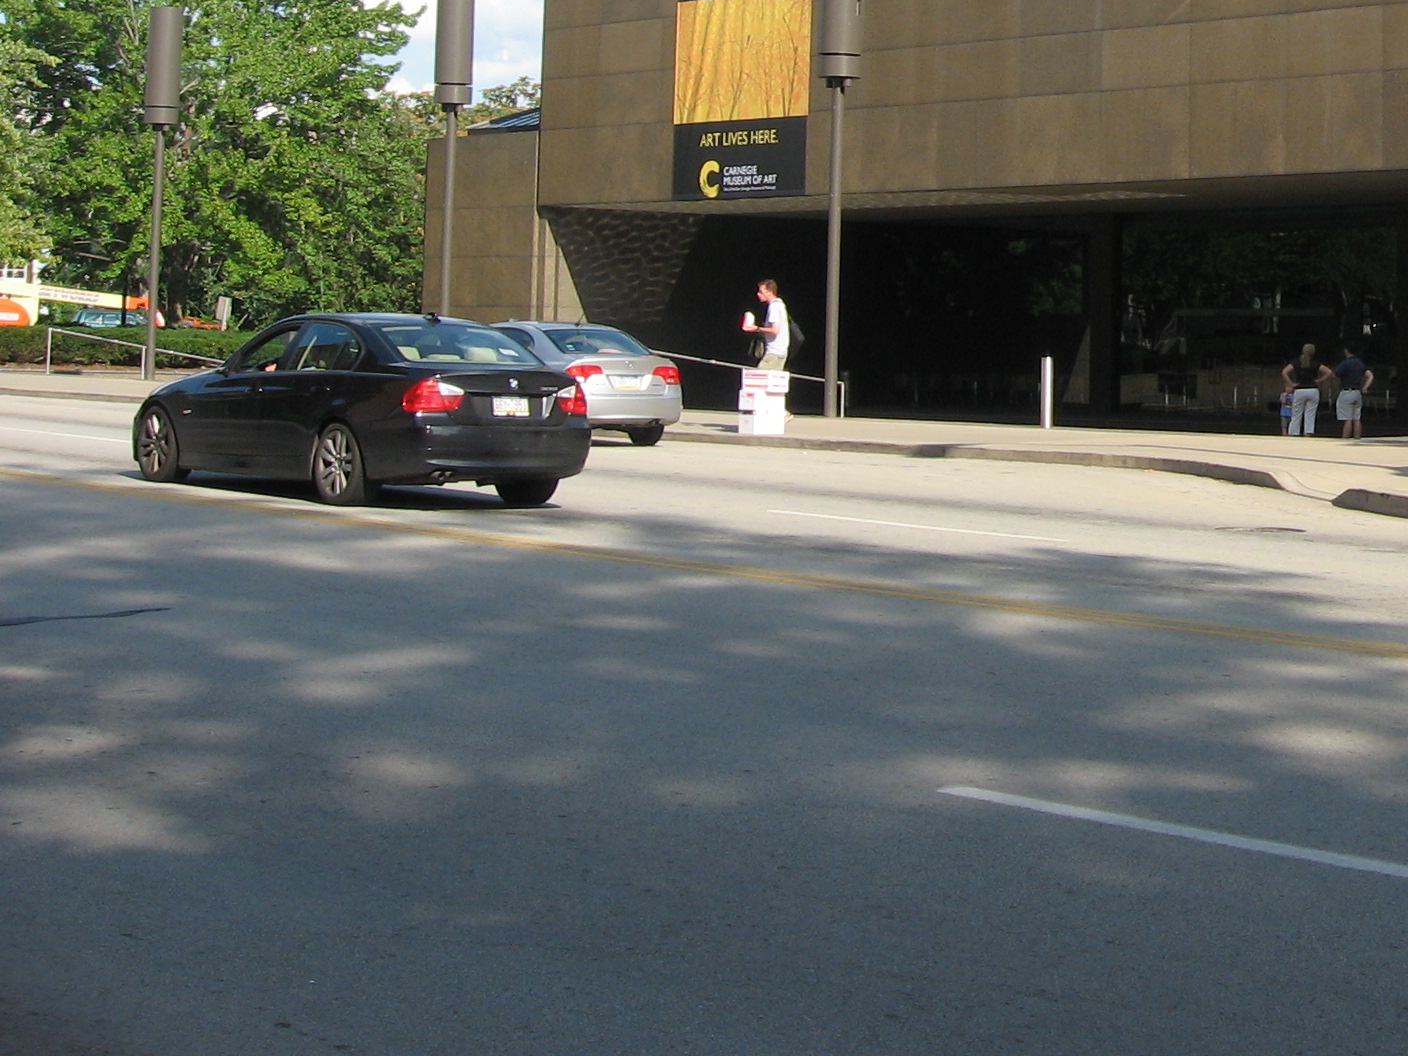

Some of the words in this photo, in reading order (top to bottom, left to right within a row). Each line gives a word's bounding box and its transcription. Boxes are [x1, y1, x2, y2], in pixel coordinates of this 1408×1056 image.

[700, 132, 721, 147] ART
[722, 131, 748, 146] LIVES
[723, 165, 758, 176] CARNEGIE
[723, 175, 752, 186] MUSEUM
[753, 175, 763, 185] OF
[763, 174, 778, 184] ART
